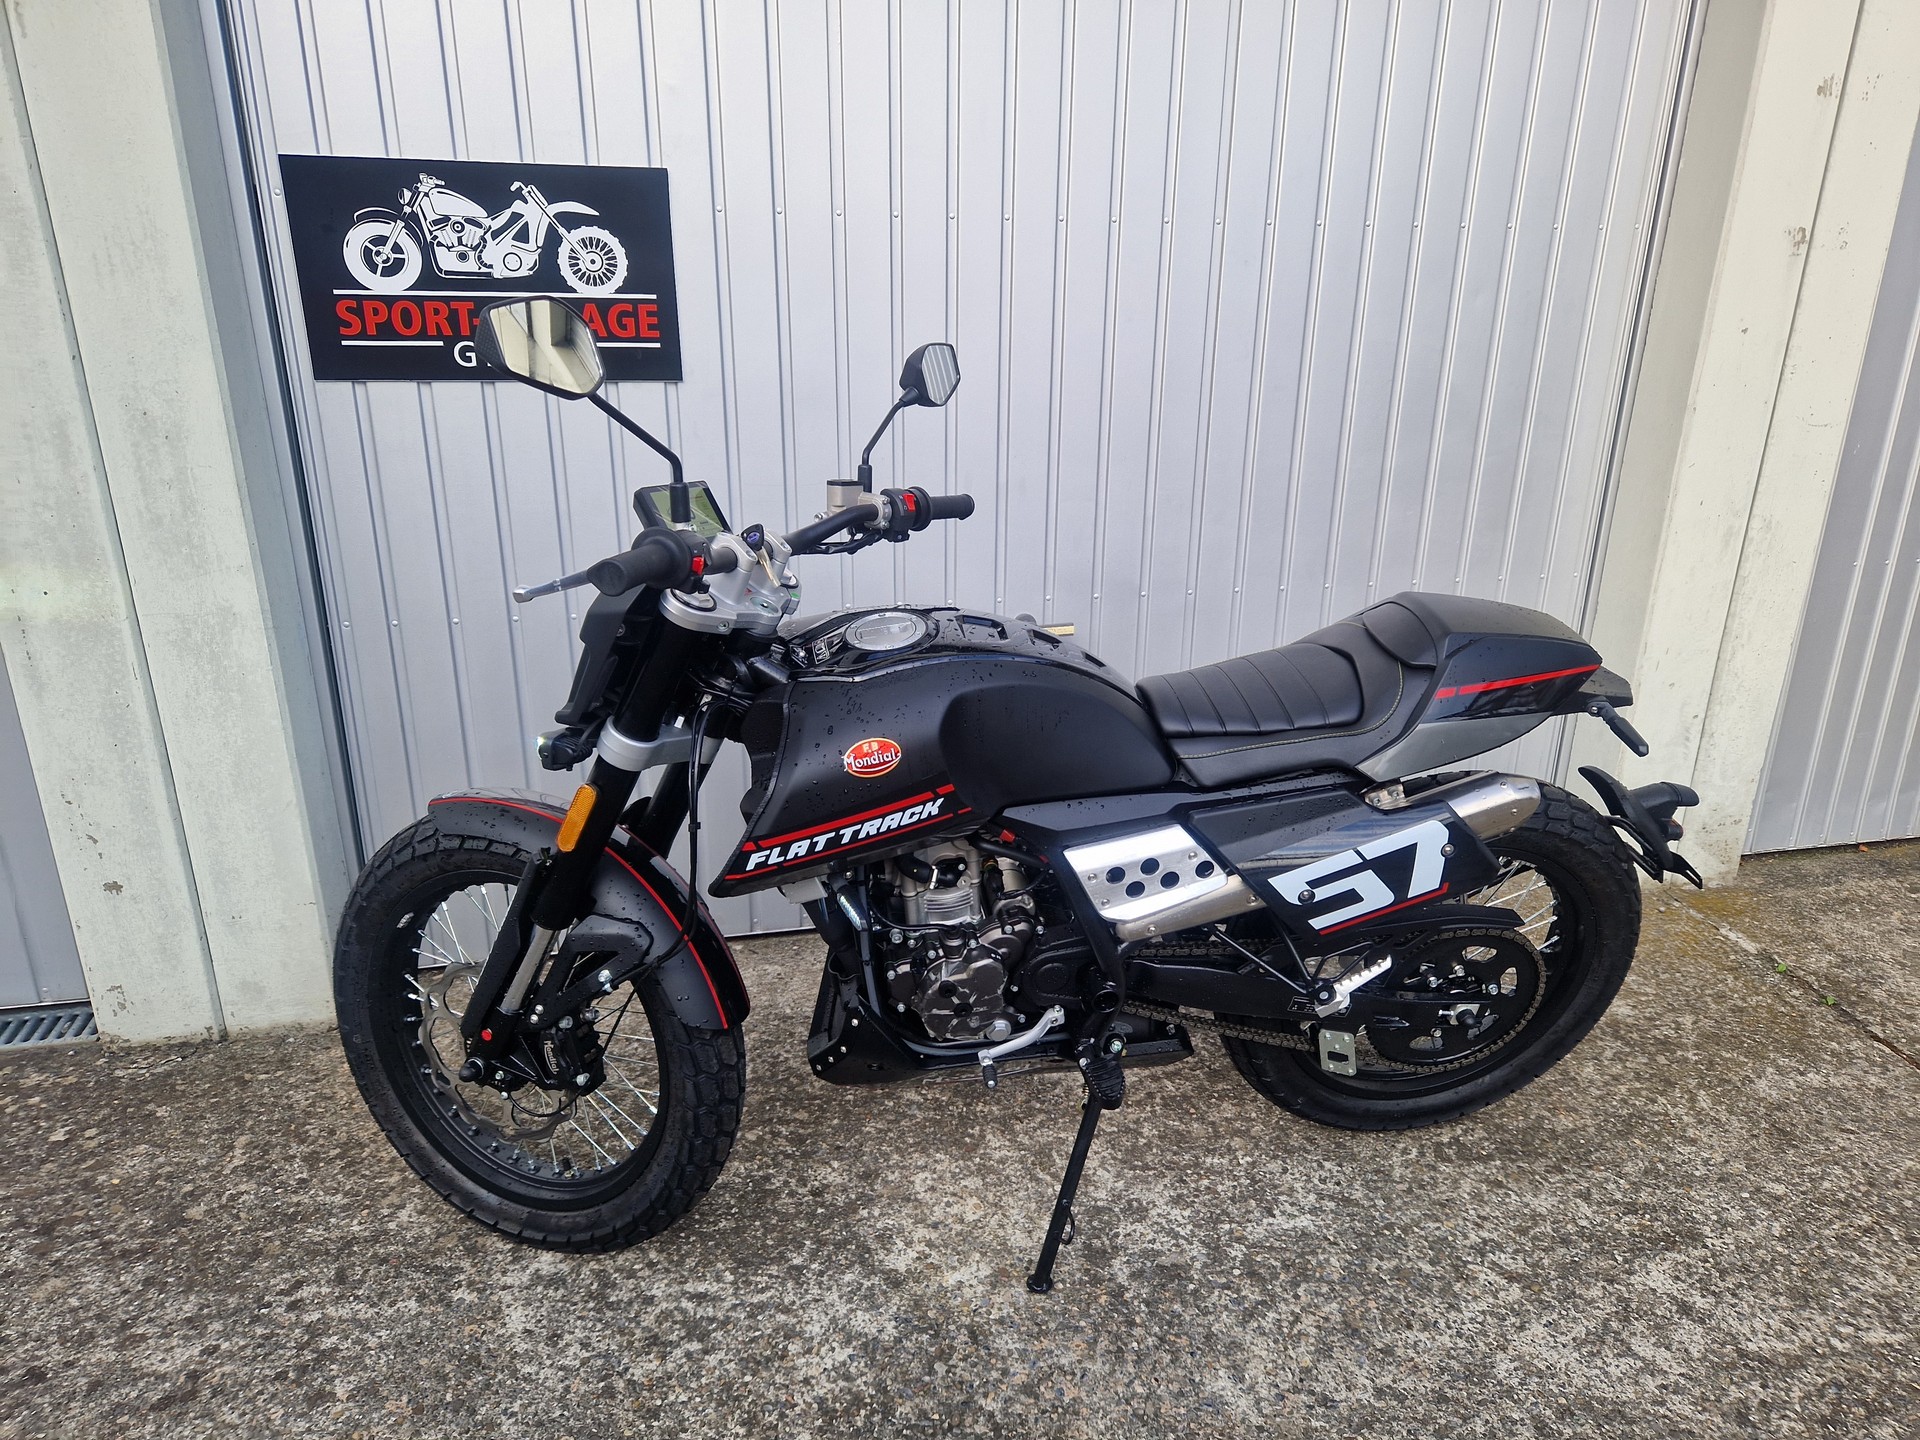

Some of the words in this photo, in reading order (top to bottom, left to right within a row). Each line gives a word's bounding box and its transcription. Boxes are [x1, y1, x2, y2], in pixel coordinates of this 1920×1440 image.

[335, 299, 661, 338] SPORT-AGE
[841, 748, 902, 772] Mondial
[745, 832, 836, 871] FLAT
[838, 798, 944, 845] TRACK
[1267, 820, 1450, 930] 57
[543, 1040, 560, 1075] Mondial
